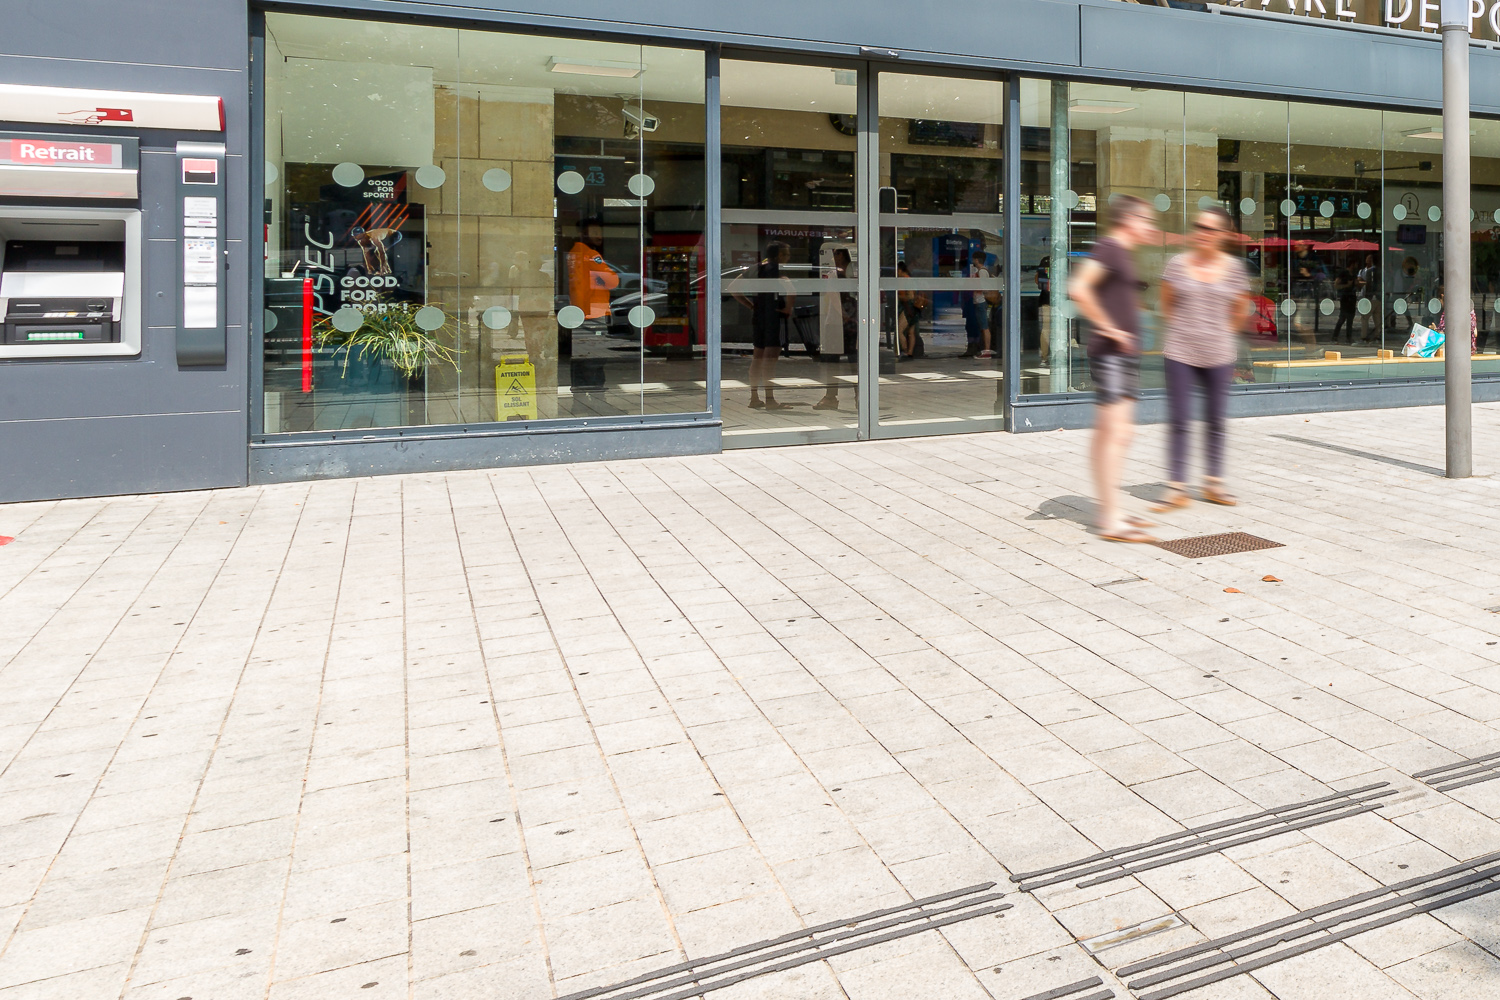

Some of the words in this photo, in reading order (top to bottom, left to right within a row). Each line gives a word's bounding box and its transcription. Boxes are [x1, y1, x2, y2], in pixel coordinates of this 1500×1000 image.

[20, 143, 95, 161] Retrait
[586, 172, 605, 184] 43
[340, 276, 400, 287] GOOD.
[340, 290, 377, 300] FOR
